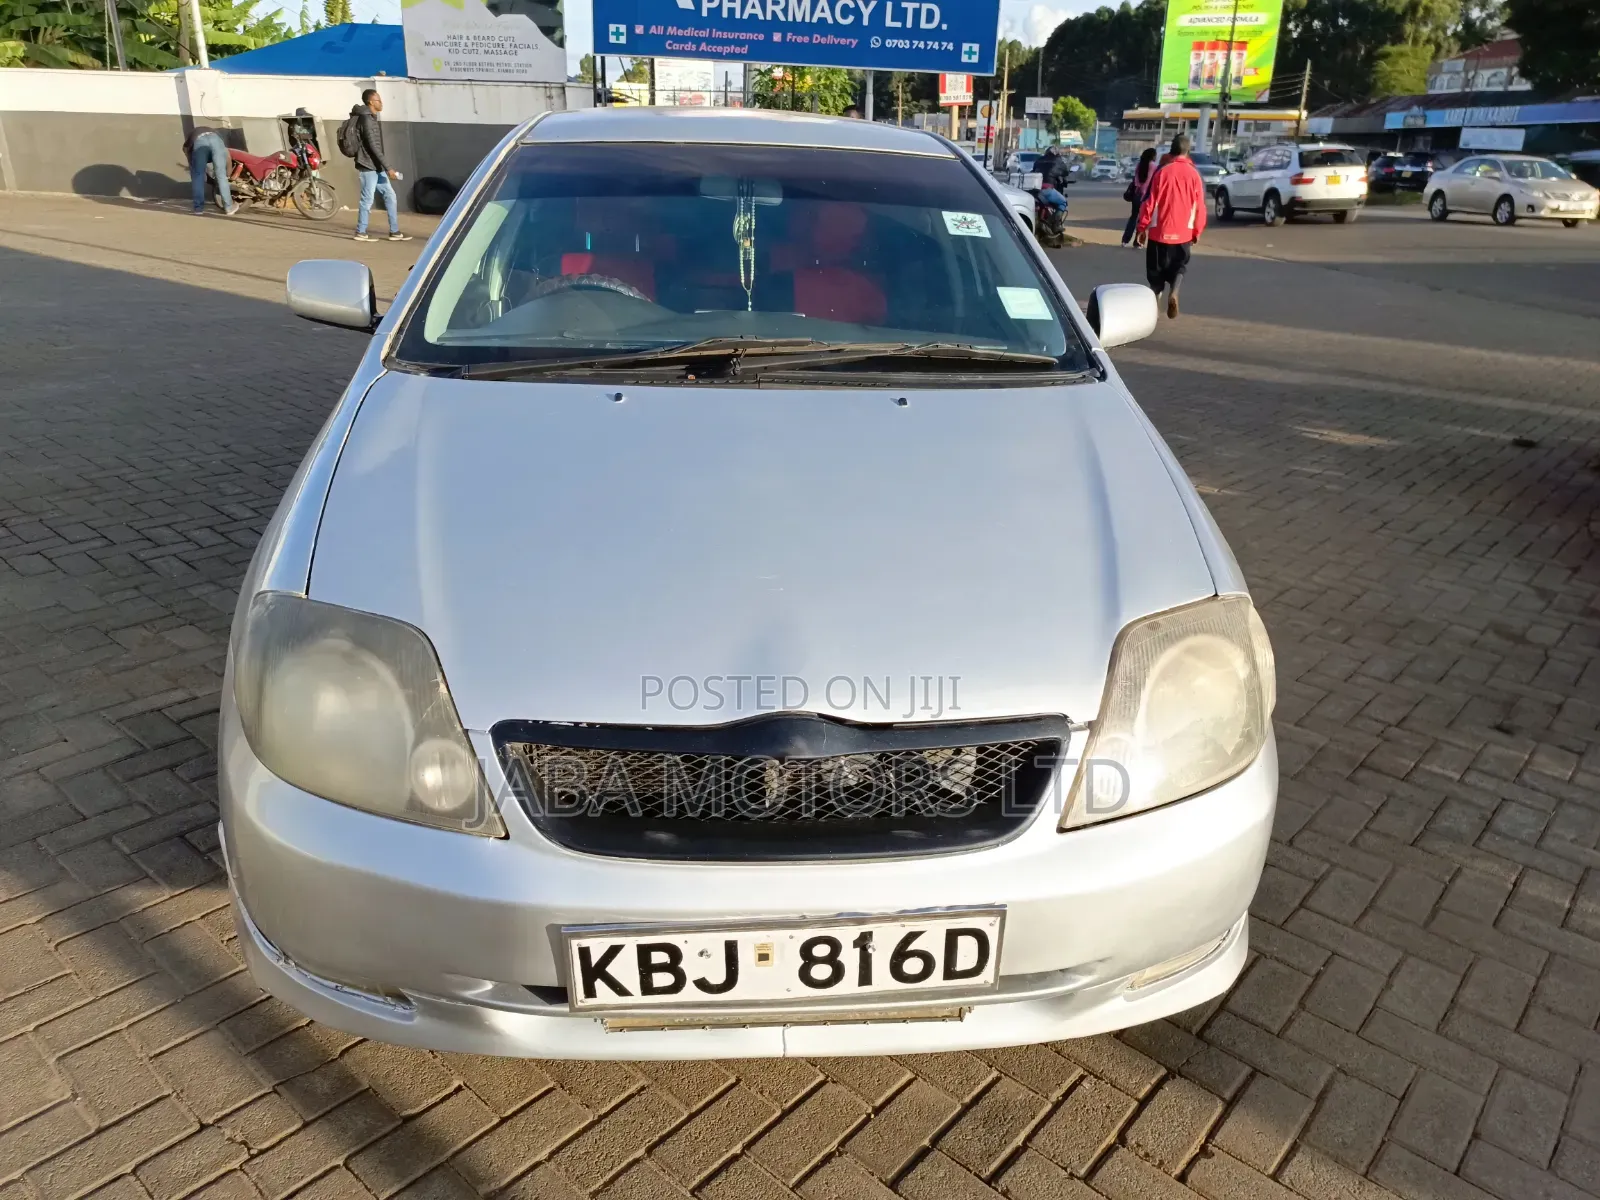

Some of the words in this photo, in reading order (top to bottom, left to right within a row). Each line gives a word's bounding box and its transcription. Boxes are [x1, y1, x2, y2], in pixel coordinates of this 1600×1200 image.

[701, 0, 879, 26] PHARMACY
[885, 1, 948, 30] LTD.
[649, 25, 664, 35] All
[666, 26, 709, 38] Medical
[711, 28, 765, 41] Insurance
[786, 32, 810, 43] Free
[812, 34, 858, 48] Delivery
[885, 39, 910, 49] 0703
[912, 40, 925, 50] 74
[926, 41, 940, 50] 74
[941, 42, 954, 51] 74
[665, 40, 697, 51] Cards
[699, 42, 748, 56] Accepted
[577, 939, 739, 999] KBJ
[798, 927, 990, 990] 816D
